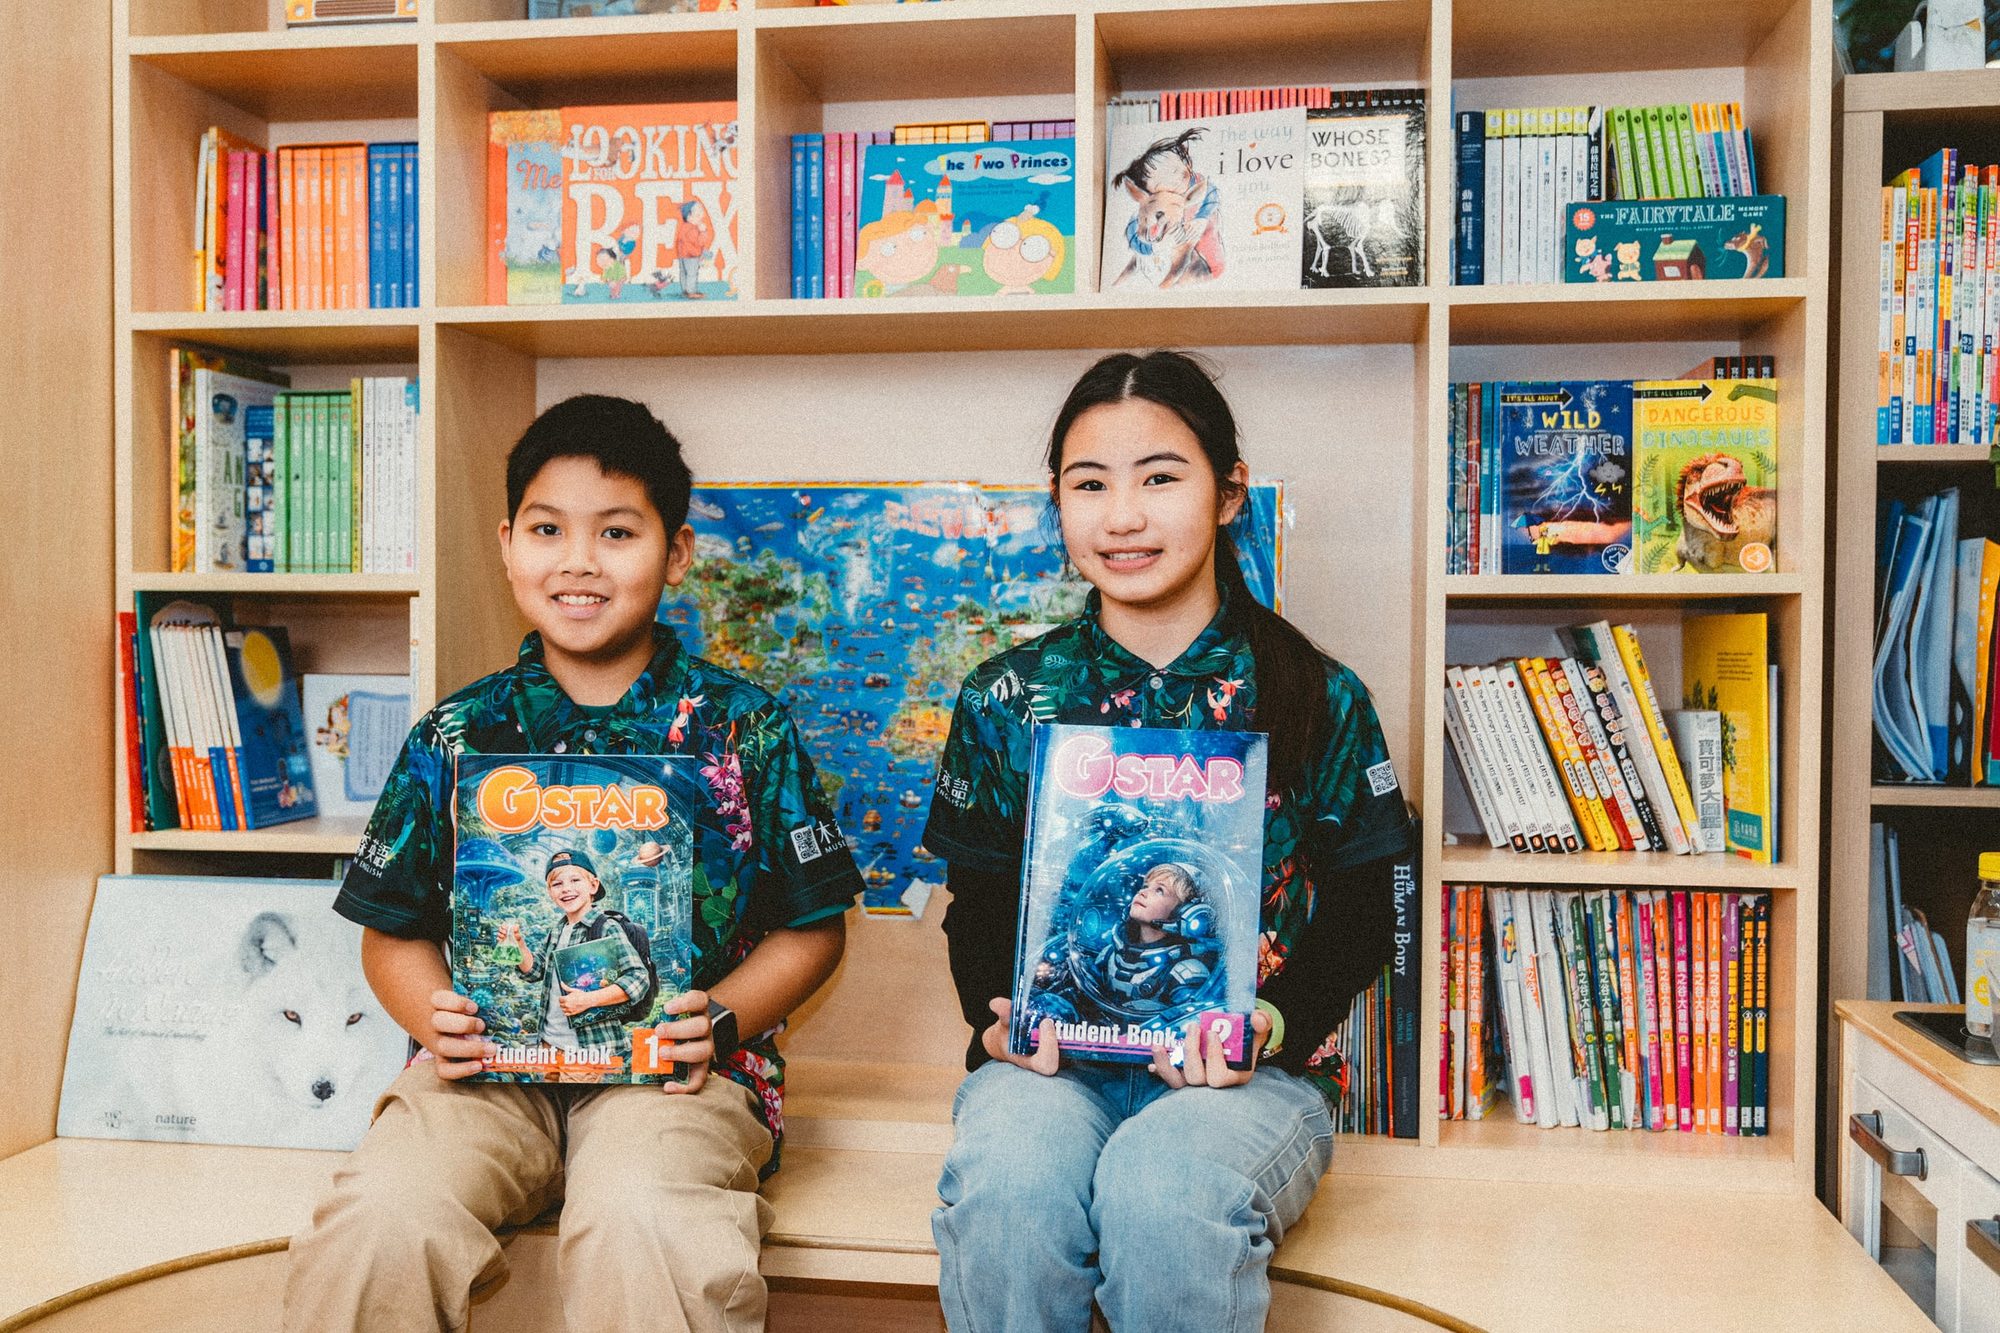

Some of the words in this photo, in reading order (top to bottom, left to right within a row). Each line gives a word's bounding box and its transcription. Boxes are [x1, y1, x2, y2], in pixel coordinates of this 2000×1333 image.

[1312, 129, 1391, 148] WHOSE
[937, 154, 965, 171] The
[973, 154, 1005, 170] Two
[1011, 153, 1068, 169] Princes
[1238, 148, 1294, 174] love
[1311, 150, 1391, 169] BONES?
[1615, 203, 1735, 225] FAIRYTALE
[566, 180, 737, 284] REX
[1537, 394, 1559, 402] ABOUT
[1674, 389, 1698, 397] ABOUT
[1541, 410, 1602, 430] WILD
[1649, 407, 1766, 425] DANGEROUS
[1514, 433, 1626, 456] WEATHER
[1643, 429, 1773, 448] DINOSAURS
[936, 786, 966, 809] ENGLISH
[359, 860, 383, 879] ENGLISH
[1405, 880, 1416, 896] The
[1052, 1021, 1121, 1046] tudent
[1127, 1024, 1177, 1048] Book
[564, 1045, 613, 1066] Book
[644, 1035, 659, 1068] 1
[155, 1114, 197, 1126] nature
